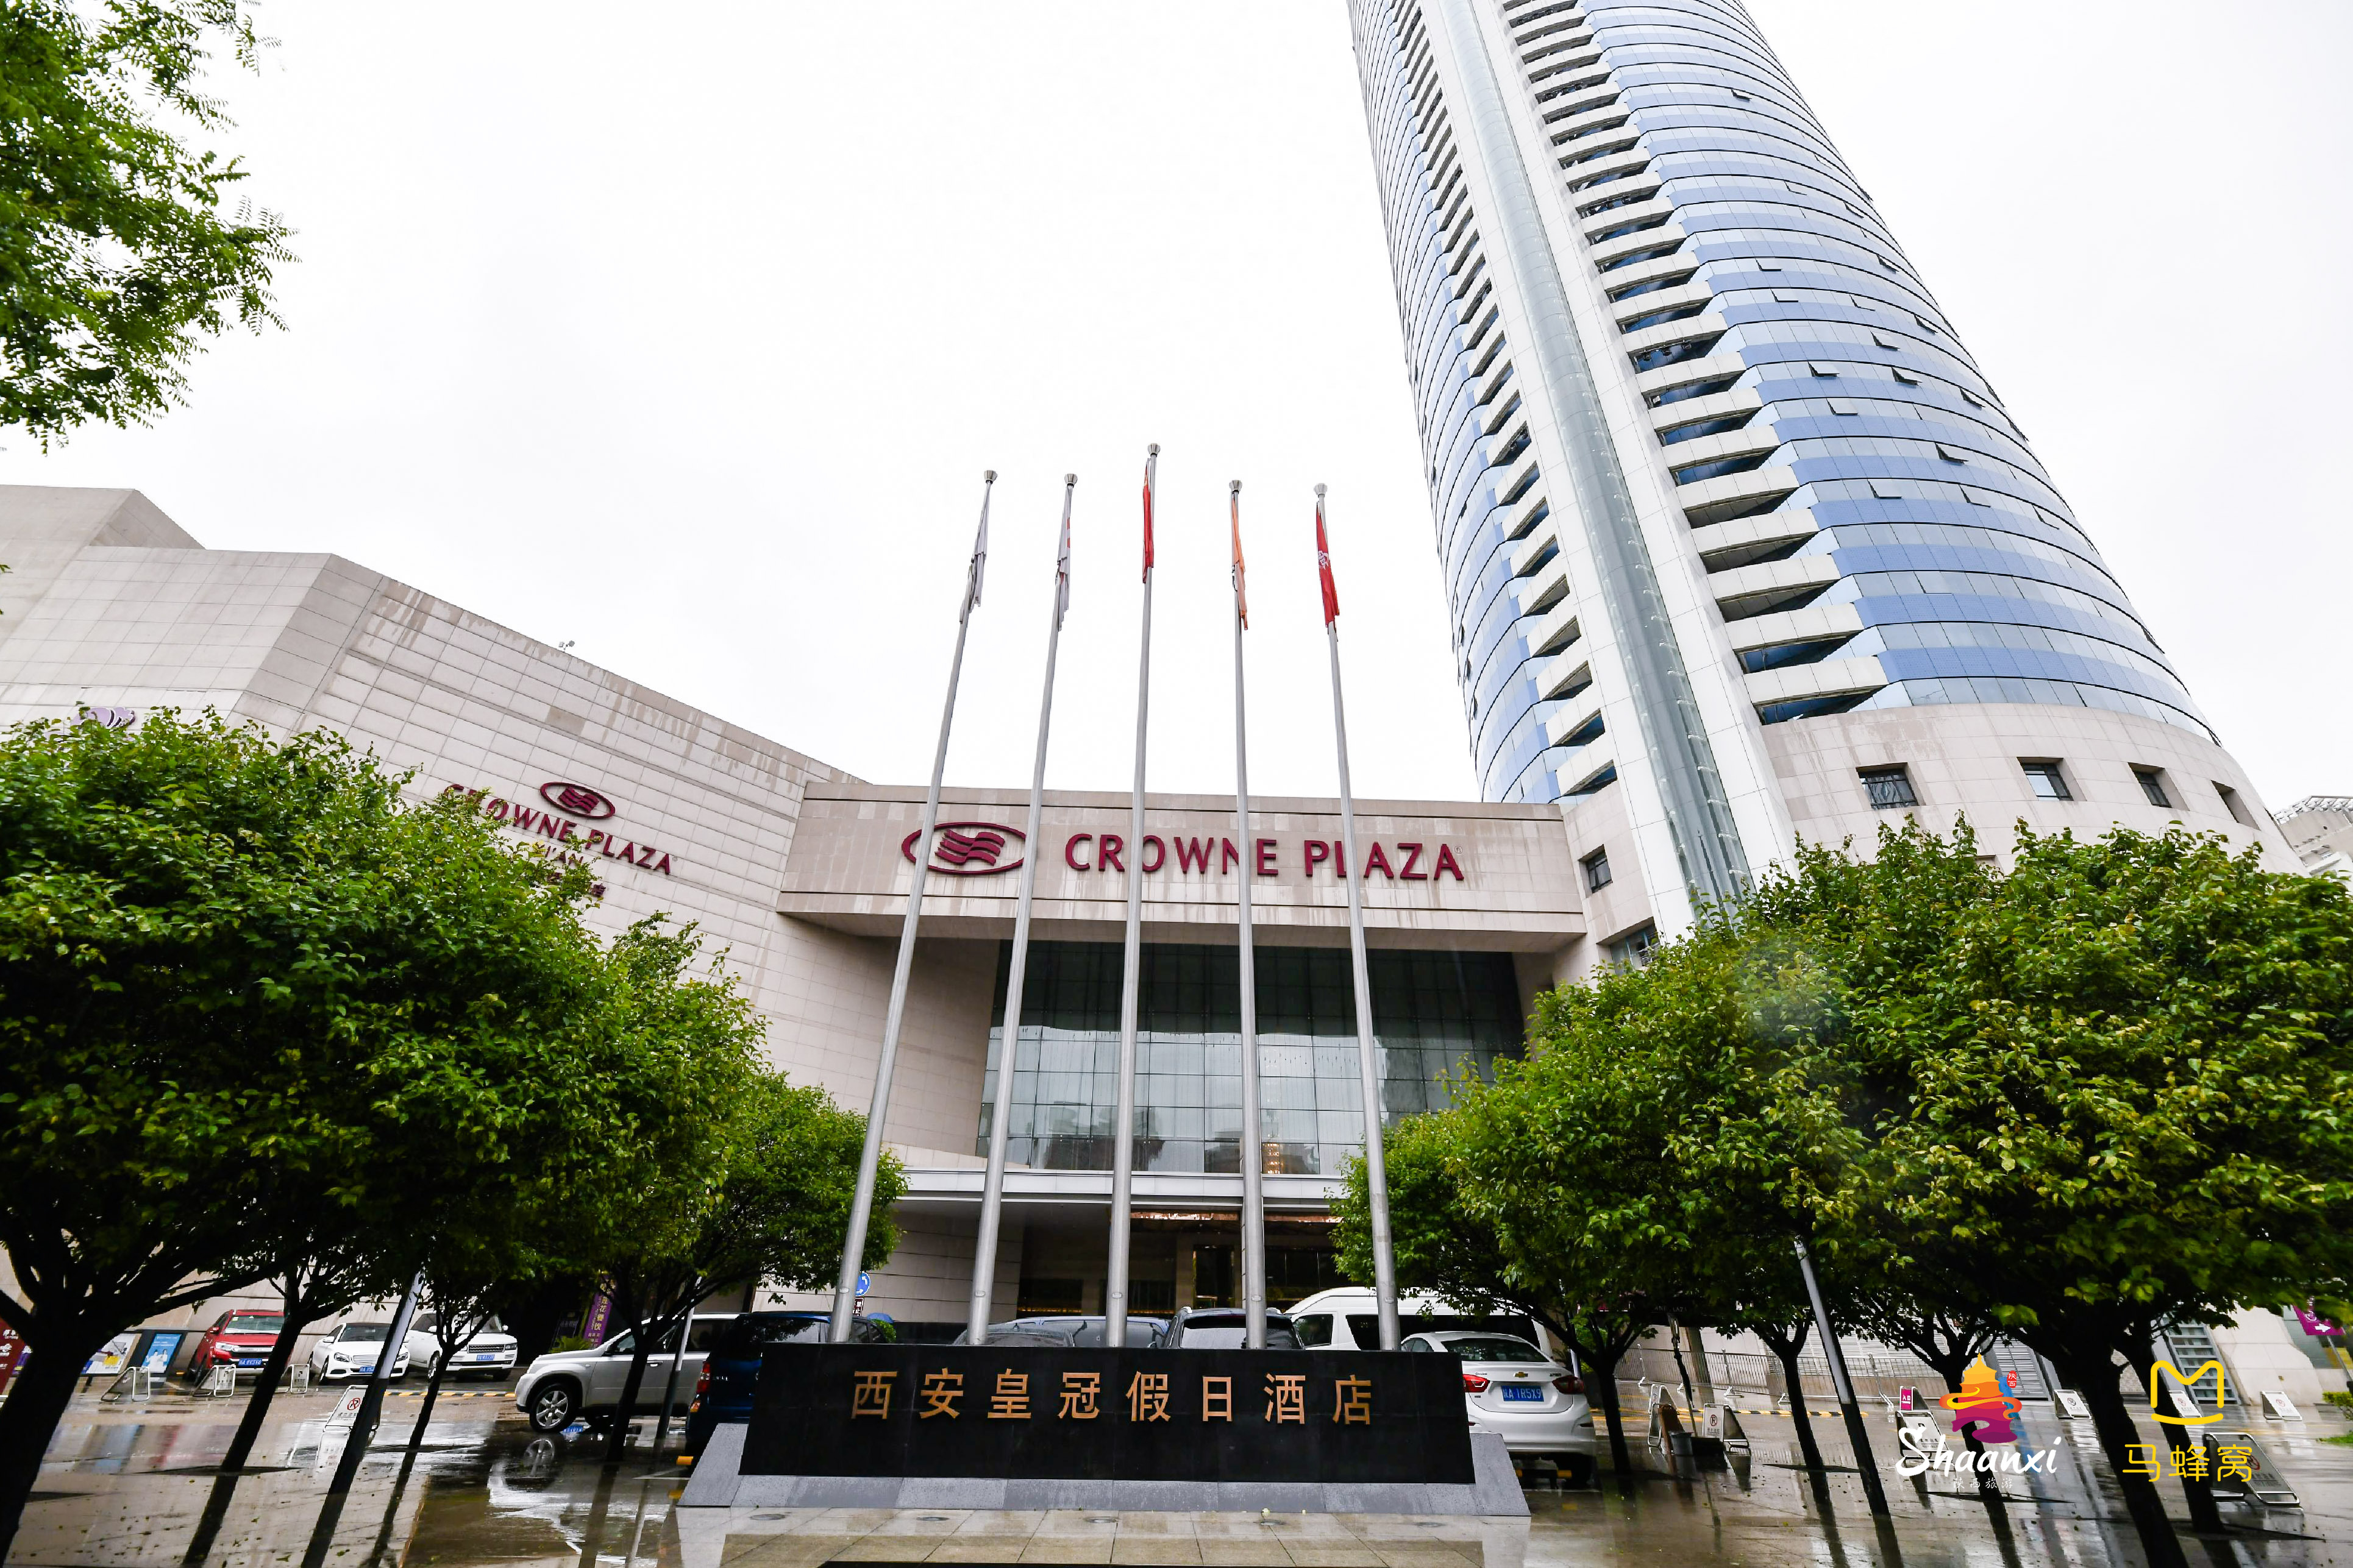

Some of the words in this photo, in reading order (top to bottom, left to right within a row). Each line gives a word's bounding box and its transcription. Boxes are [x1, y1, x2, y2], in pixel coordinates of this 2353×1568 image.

[585, 829, 671, 875] PLAZA
[1064, 833, 1279, 876] CROWNE
[1303, 840, 1465, 881] PLAZA
[852, 1367, 1372, 1425] 西安皇冠假日酒店
